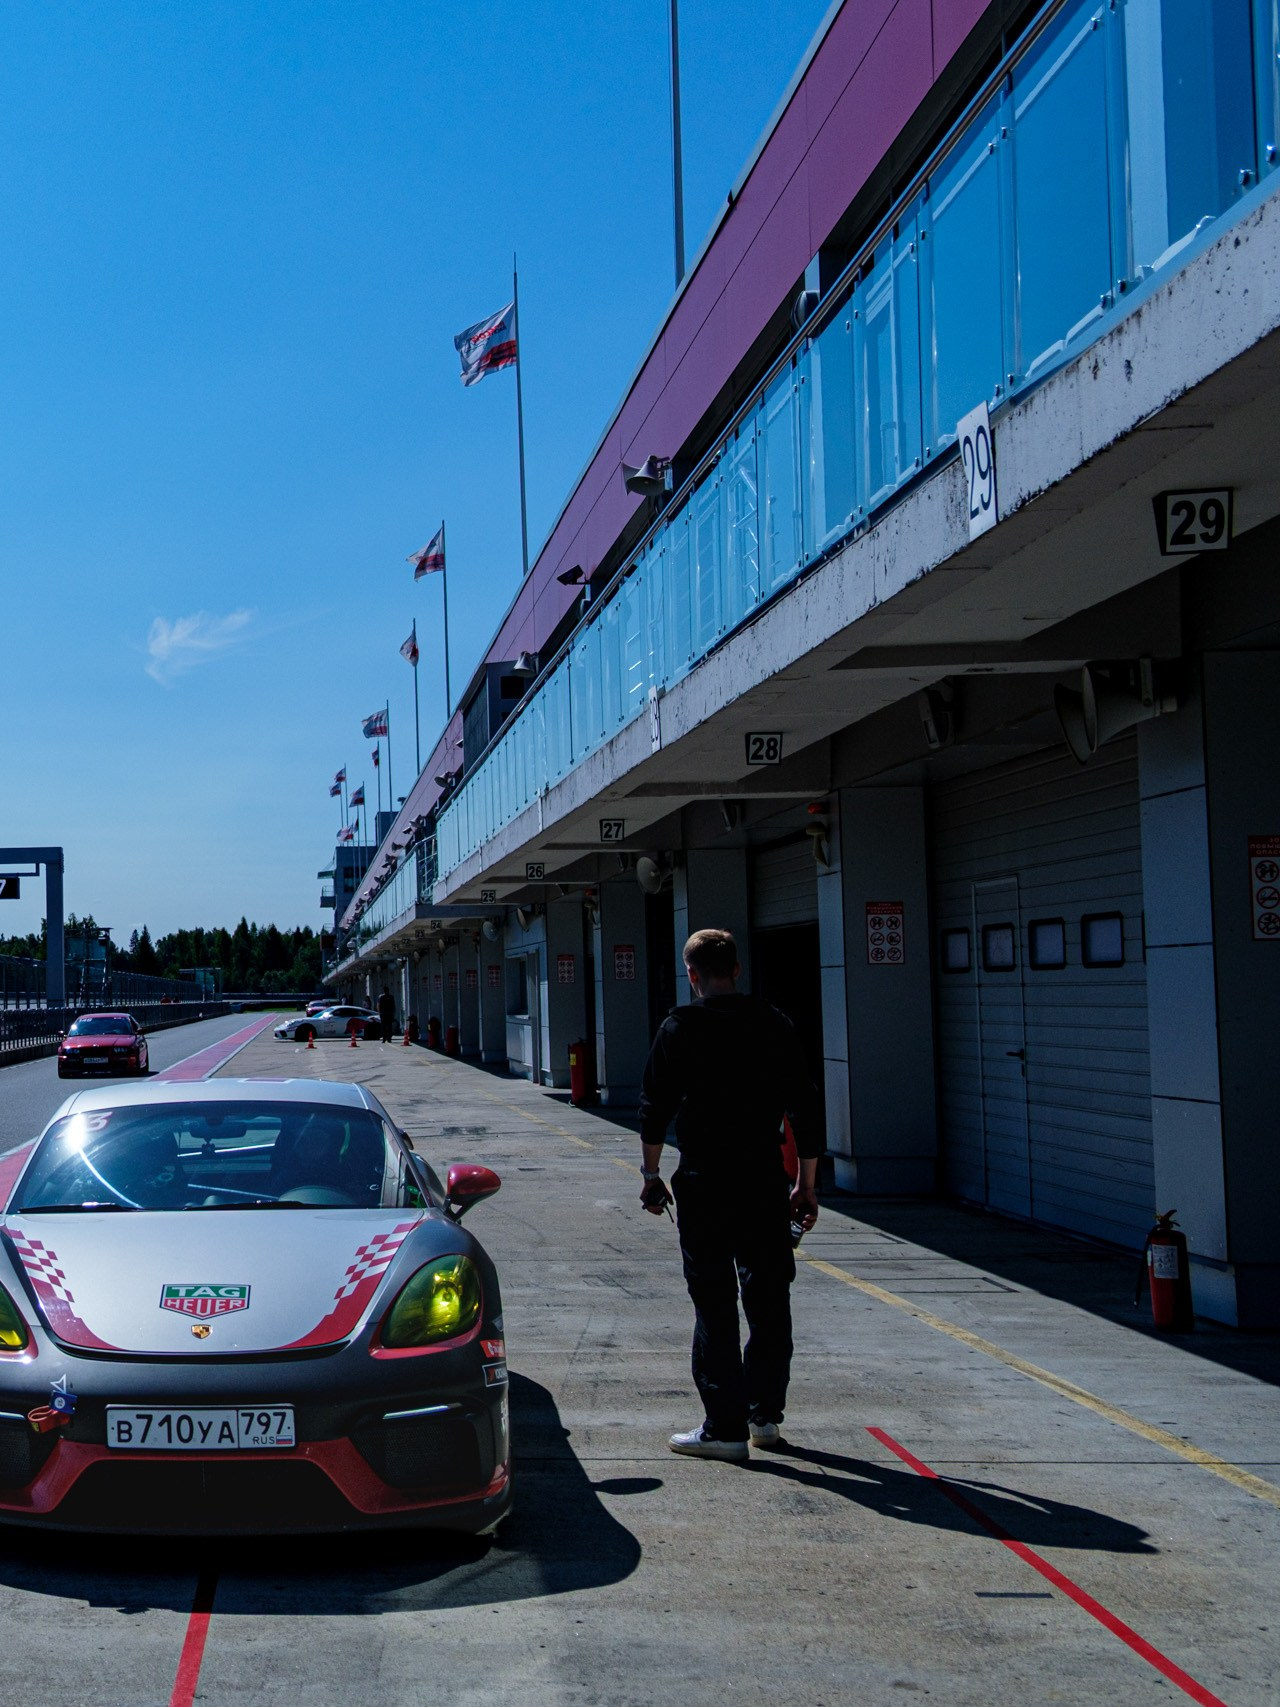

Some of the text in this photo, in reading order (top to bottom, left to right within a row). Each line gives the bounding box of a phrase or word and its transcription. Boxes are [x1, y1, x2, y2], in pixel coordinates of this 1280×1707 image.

[963, 425, 993, 520] 29
[1170, 498, 1225, 545] 29
[750, 737, 778, 761] 28
[603, 822, 622, 839] 27
[528, 865, 543, 878] 26
[483, 892, 494, 903] 25
[171, 1286, 240, 1297] TAG
[166, 1299, 242, 1316] HEUER
[117, 1412, 287, 1444] В710УА 797
[252, 1436, 275, 1445] RUS
